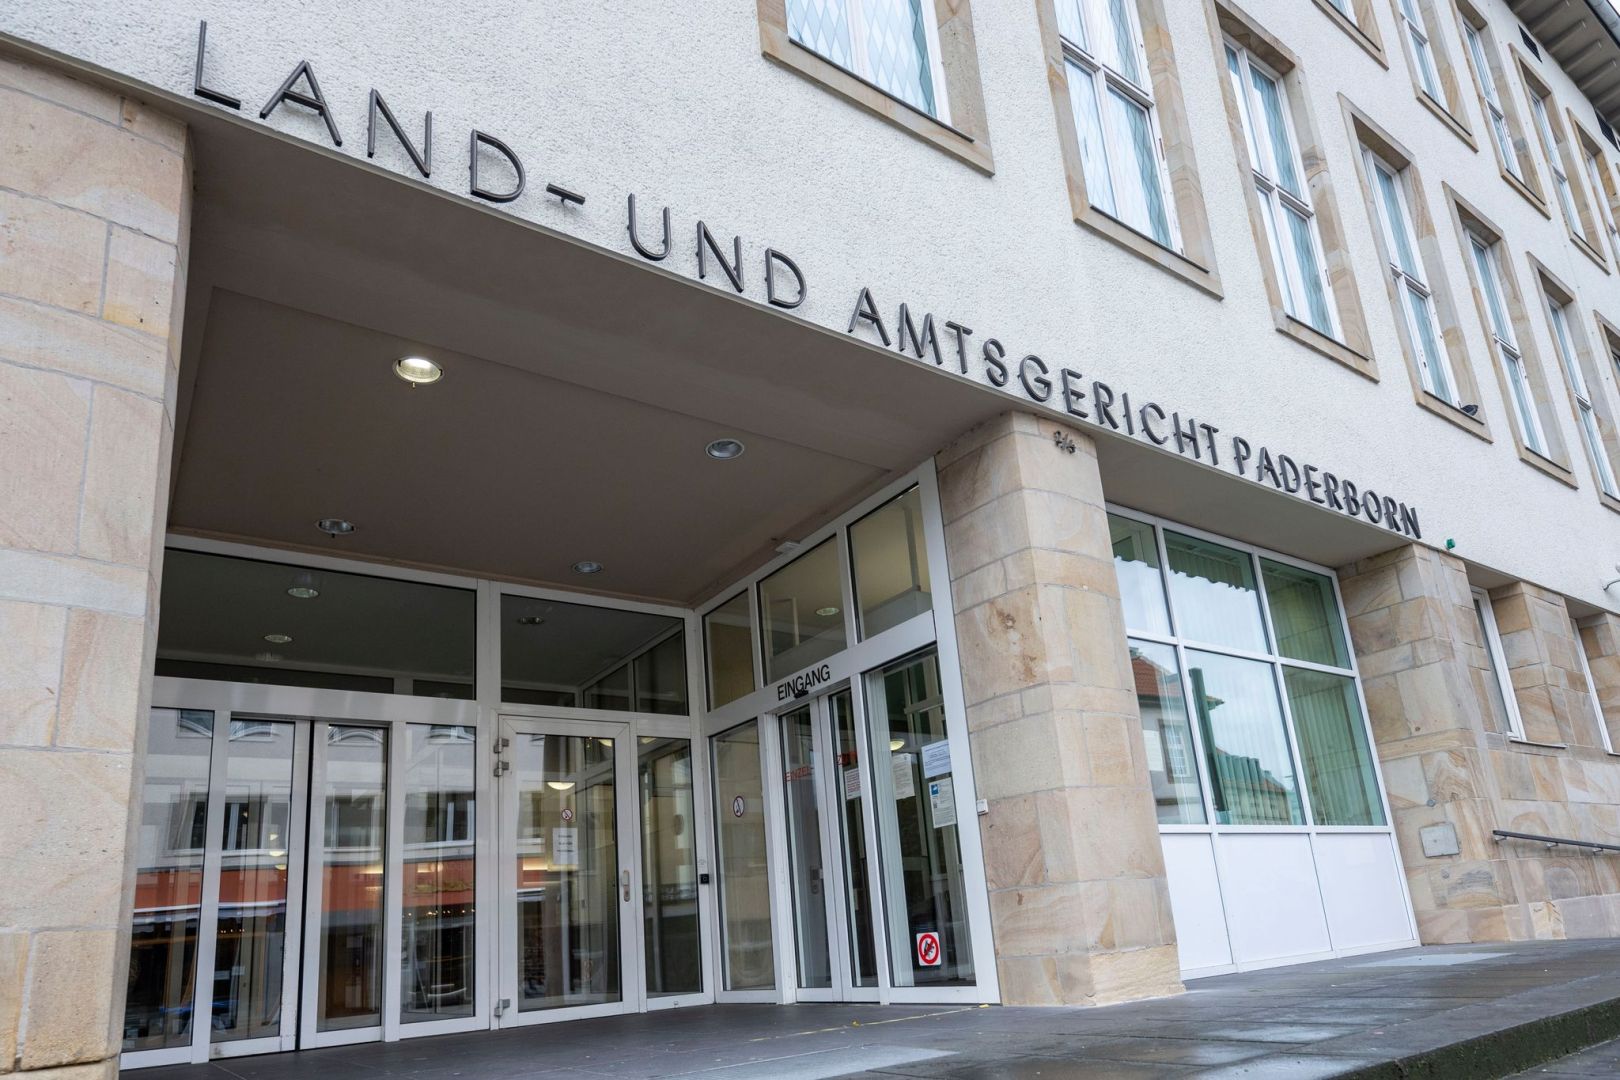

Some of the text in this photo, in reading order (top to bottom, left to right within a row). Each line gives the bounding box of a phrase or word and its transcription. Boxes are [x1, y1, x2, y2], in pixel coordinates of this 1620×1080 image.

[194, 20, 1422, 540] LAND- UND AMTSGERICHT PADERBORN
[777, 664, 831, 701] EINGANG
